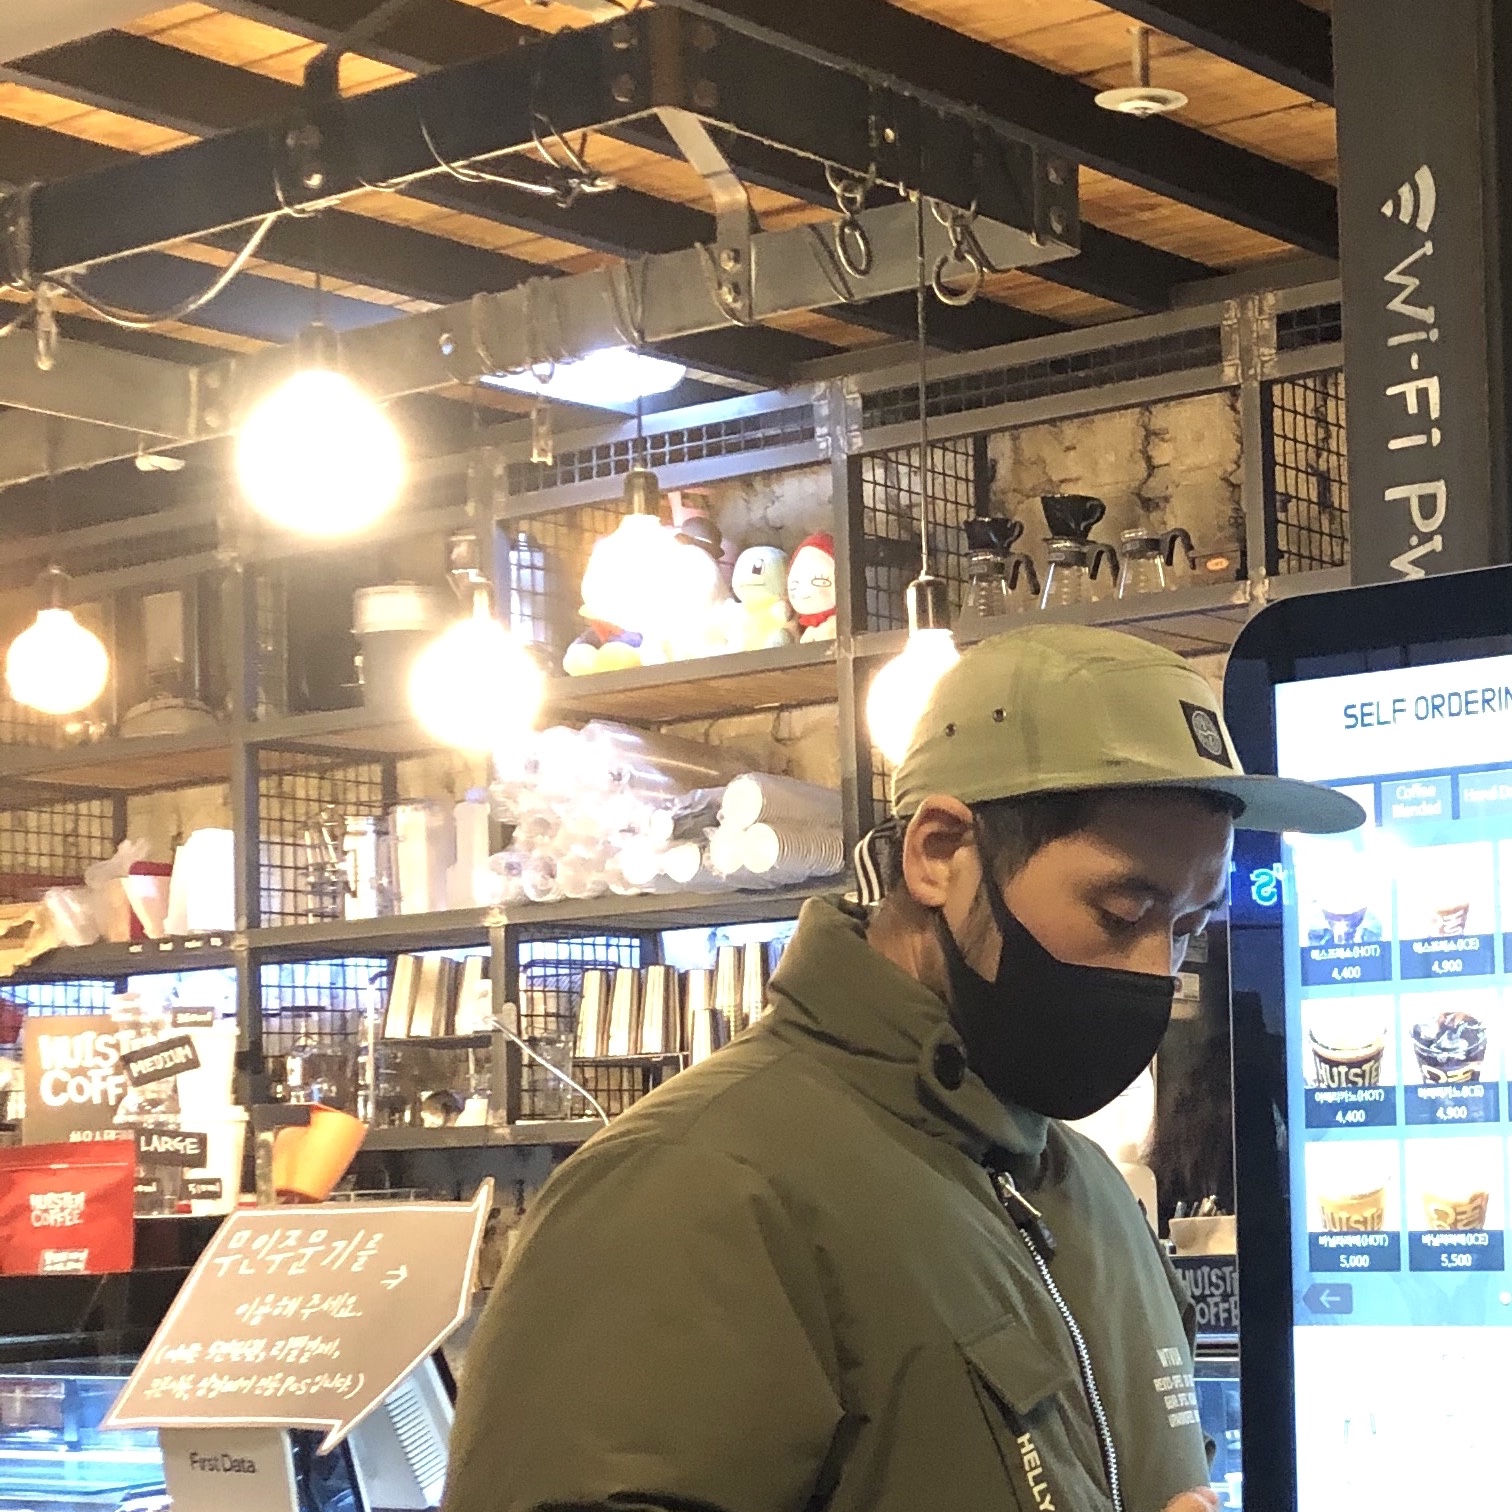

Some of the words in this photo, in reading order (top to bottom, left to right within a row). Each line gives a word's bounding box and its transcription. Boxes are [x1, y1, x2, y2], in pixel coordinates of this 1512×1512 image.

[1344, 698, 1407, 730] SELF
[130, 1043, 193, 1077] MEDIUM
[140, 1135, 201, 1154] LARGE
[213, 1228, 384, 1277] 무인주문기를
[1017, 1432, 1056, 1512] HELLY
